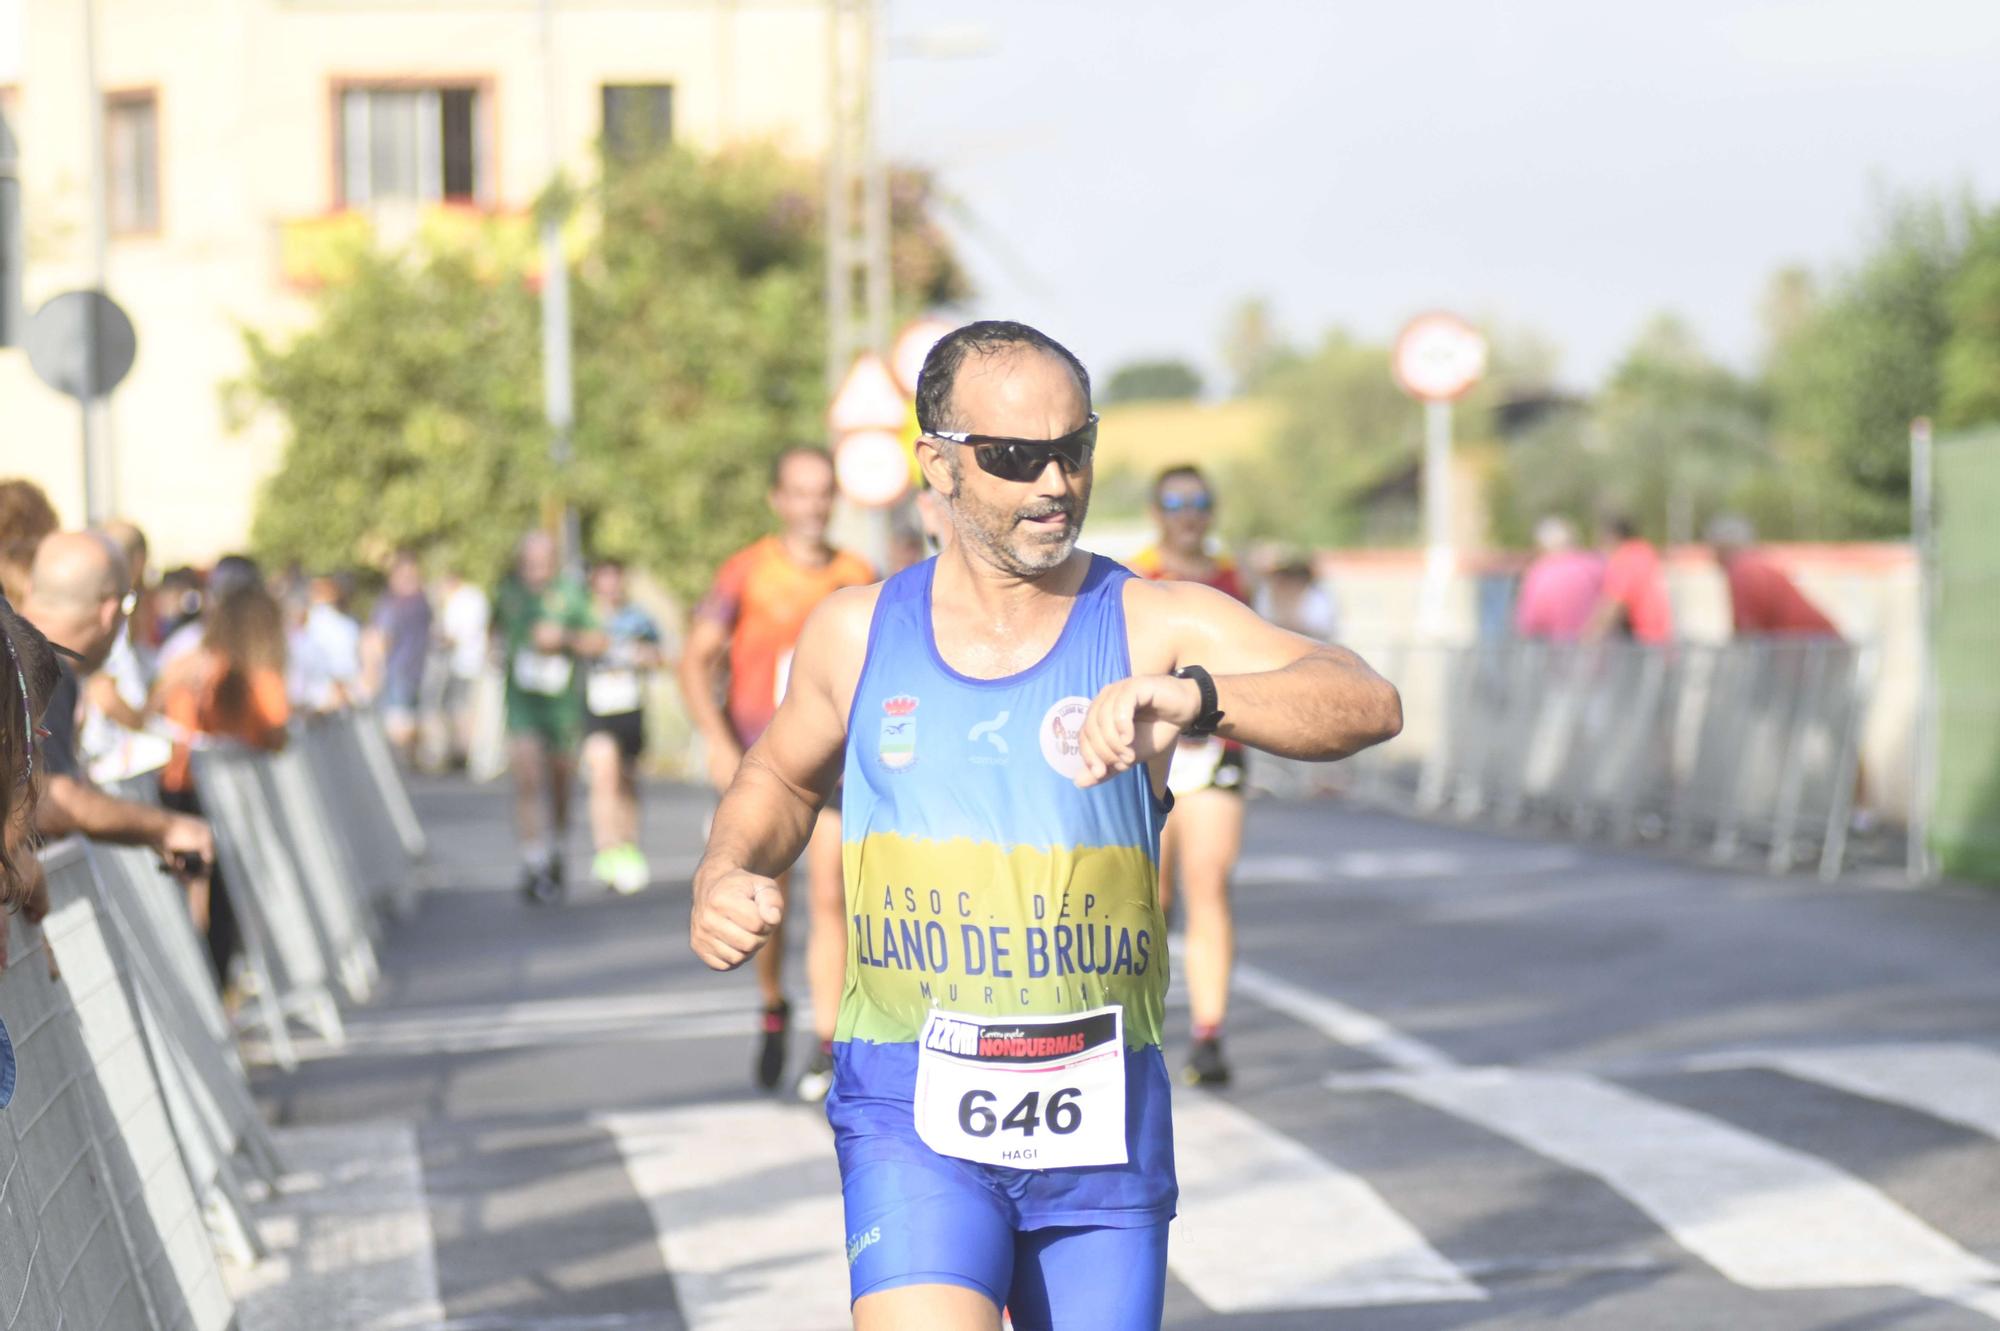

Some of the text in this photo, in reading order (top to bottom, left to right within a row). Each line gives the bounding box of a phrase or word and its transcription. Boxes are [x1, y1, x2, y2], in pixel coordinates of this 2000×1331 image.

[884, 885, 1109, 919] ASOC. DEP.
[855, 915, 1151, 979] LLANO DE BRUJAS
[920, 981, 1089, 1005] MURCIA
[979, 1033, 1085, 1057] NONDUERMAS
[958, 1087, 1082, 1138] 646
[1002, 1149, 1037, 1160] HAGI
